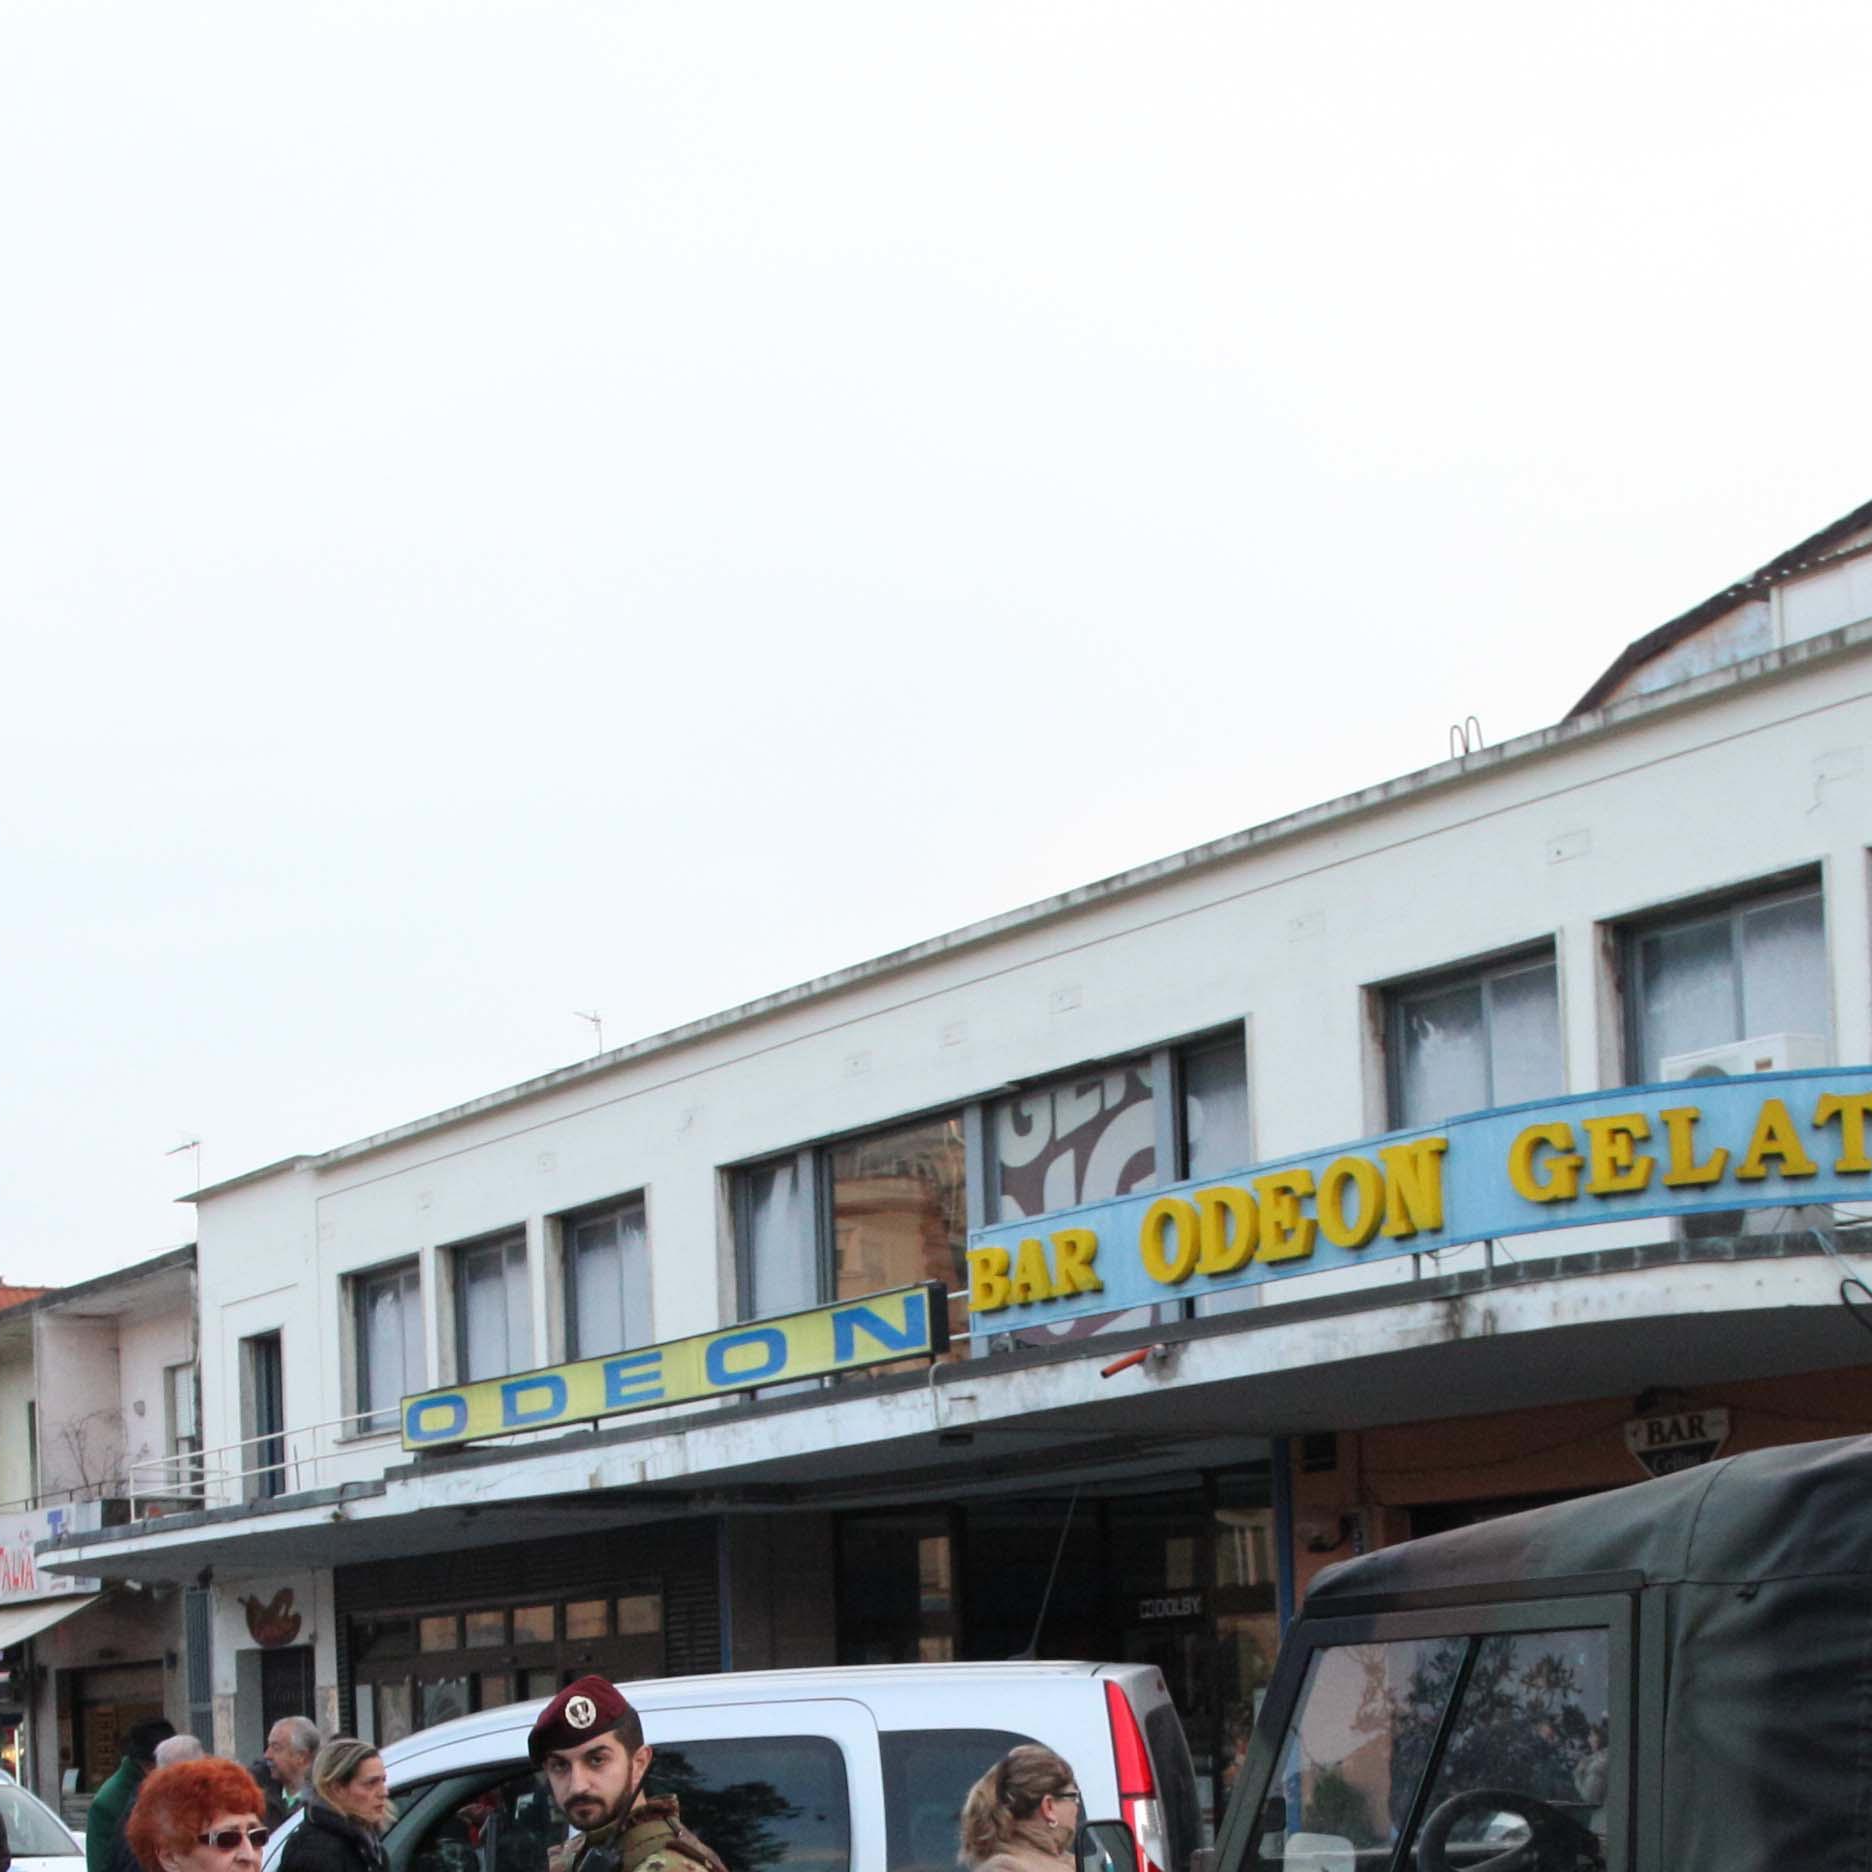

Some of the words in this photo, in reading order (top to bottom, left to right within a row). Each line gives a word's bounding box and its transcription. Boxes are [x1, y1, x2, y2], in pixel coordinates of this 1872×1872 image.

[966, 1228, 1103, 1312] BAR
[1140, 1136, 1448, 1284] ODEON
[405, 1292, 928, 1442] ODEON
[1647, 1414, 1707, 1446] BAR
